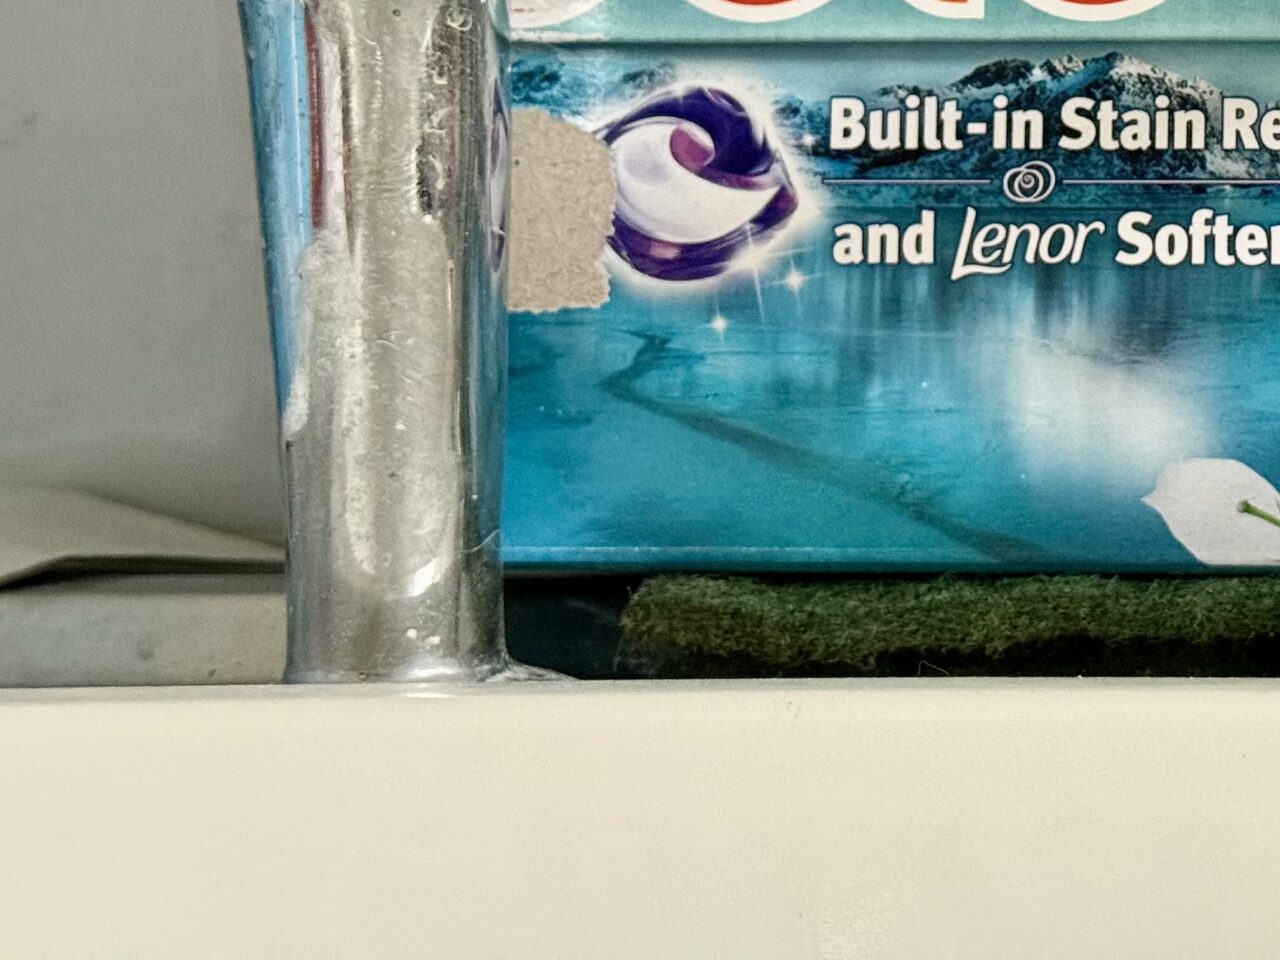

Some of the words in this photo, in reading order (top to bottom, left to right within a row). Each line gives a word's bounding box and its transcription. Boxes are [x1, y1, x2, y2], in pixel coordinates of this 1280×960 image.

[829, 94, 1044, 151] Built-in
[1058, 95, 1206, 151] Stain
[832, 209, 936, 266] and
[951, 206, 1106, 281] Lenor
